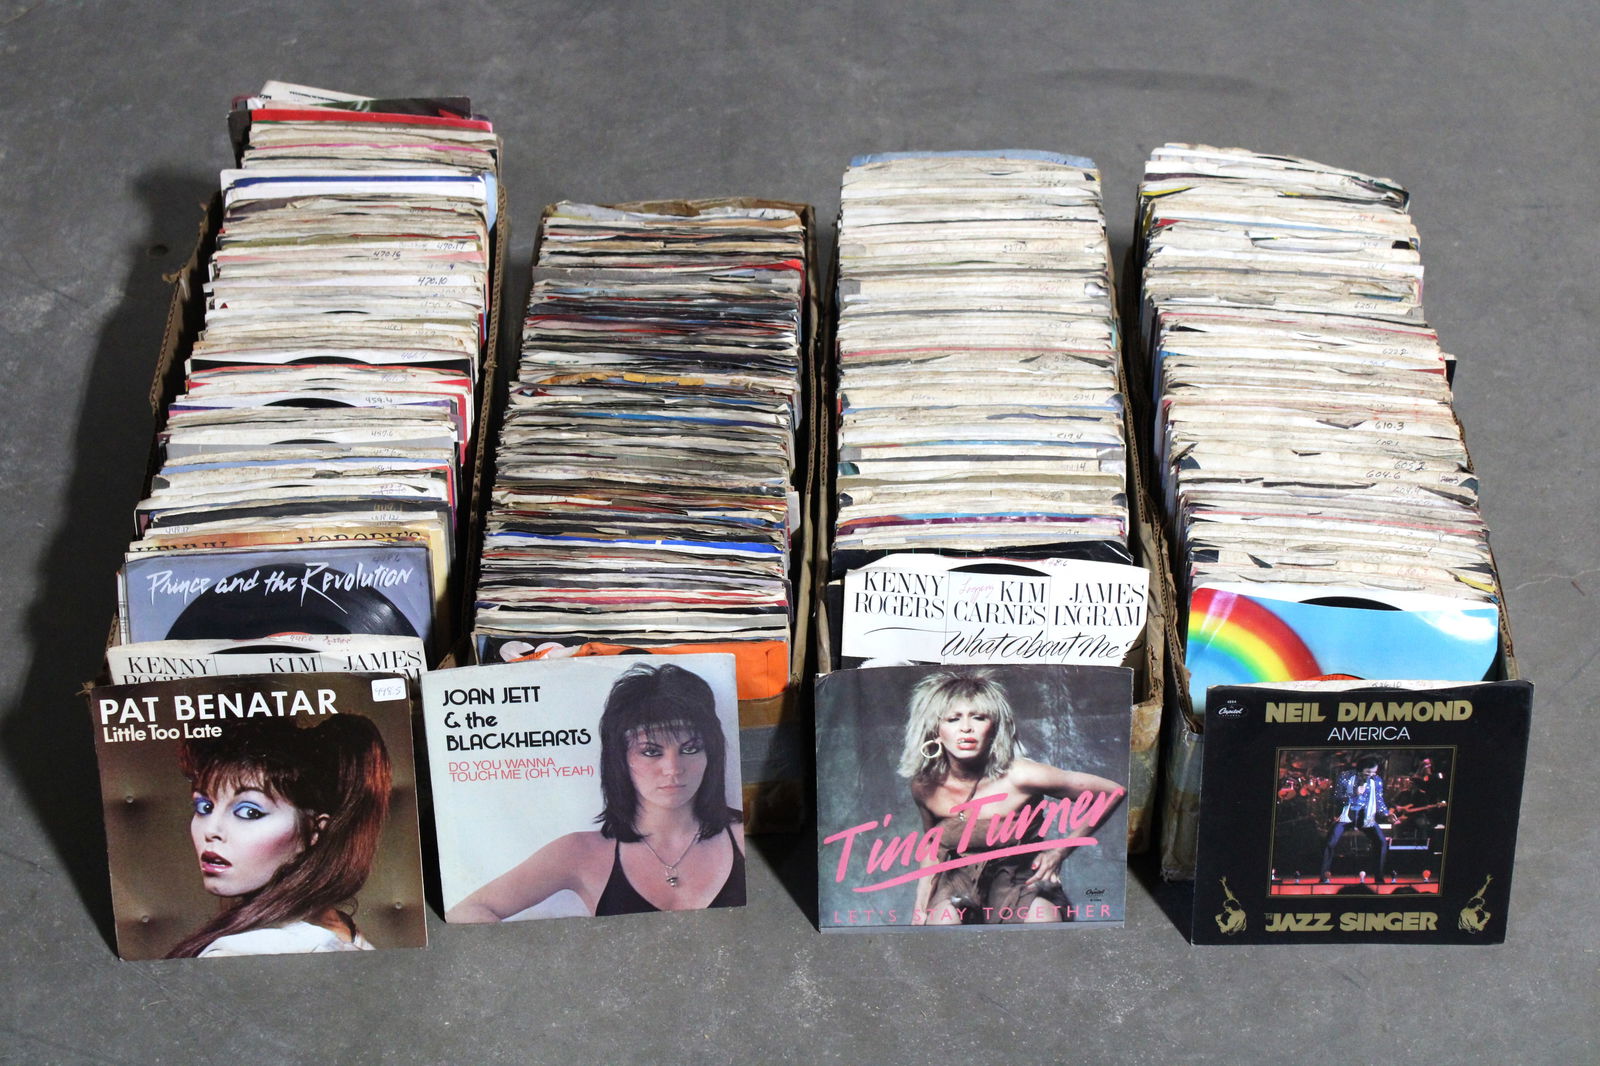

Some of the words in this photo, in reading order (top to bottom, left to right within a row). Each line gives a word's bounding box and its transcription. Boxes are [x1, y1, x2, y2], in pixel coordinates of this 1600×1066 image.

[146, 570, 208, 606] Prince
[215, 570, 260, 594] and
[264, 570, 298, 596] the
[300, 562, 414, 614] Revolution
[864, 571, 944, 597] KENNY
[1000, 580, 1045, 603] KIM
[1068, 582, 1145, 604] JAMES
[854, 592, 945, 619] ROGERS
[953, 600, 1046, 626] CARNES
[1054, 605, 1141, 626] INGRAM
[940, 627, 1017, 661] What
[128, 657, 210, 675] KENNY
[269, 656, 318, 672] KIM
[343, 650, 422, 671] JAMES
[442, 688, 495, 706] JOAN
[501, 686, 541, 704] JETT
[99, 697, 159, 725] PAT
[174, 689, 338, 721] BENATAR
[1218, 706, 1244, 716] Capitol
[1265, 702, 1326, 723] NEIL
[1337, 700, 1473, 722] DIAMOND
[444, 711, 461, 729] &
[465, 711, 498, 729] the
[103, 724, 147, 743] Little
[147, 724, 181, 741] Too
[184, 722, 223, 740] Late
[446, 728, 592, 751] BLACKHEARTS
[1328, 726, 1411, 741] AMERICA
[448, 761, 470, 772] DO
[473, 760, 502, 771] YOU
[505, 757, 556, 769] WANNA
[450, 770, 498, 782] TOUCH
[501, 769, 521, 780] ME
[525, 768, 550, 781] (OH
[553, 765, 594, 778] YEAH)
[824, 813, 944, 884] Tina
[950, 787, 1125, 854] Turner
[834, 909, 898, 924] LET'S
[913, 907, 968, 922] STAY
[983, 904, 1112, 920] TOGETHER
[1265, 912, 1335, 932] JAZZ
[1339, 911, 1438, 932] SINGER
